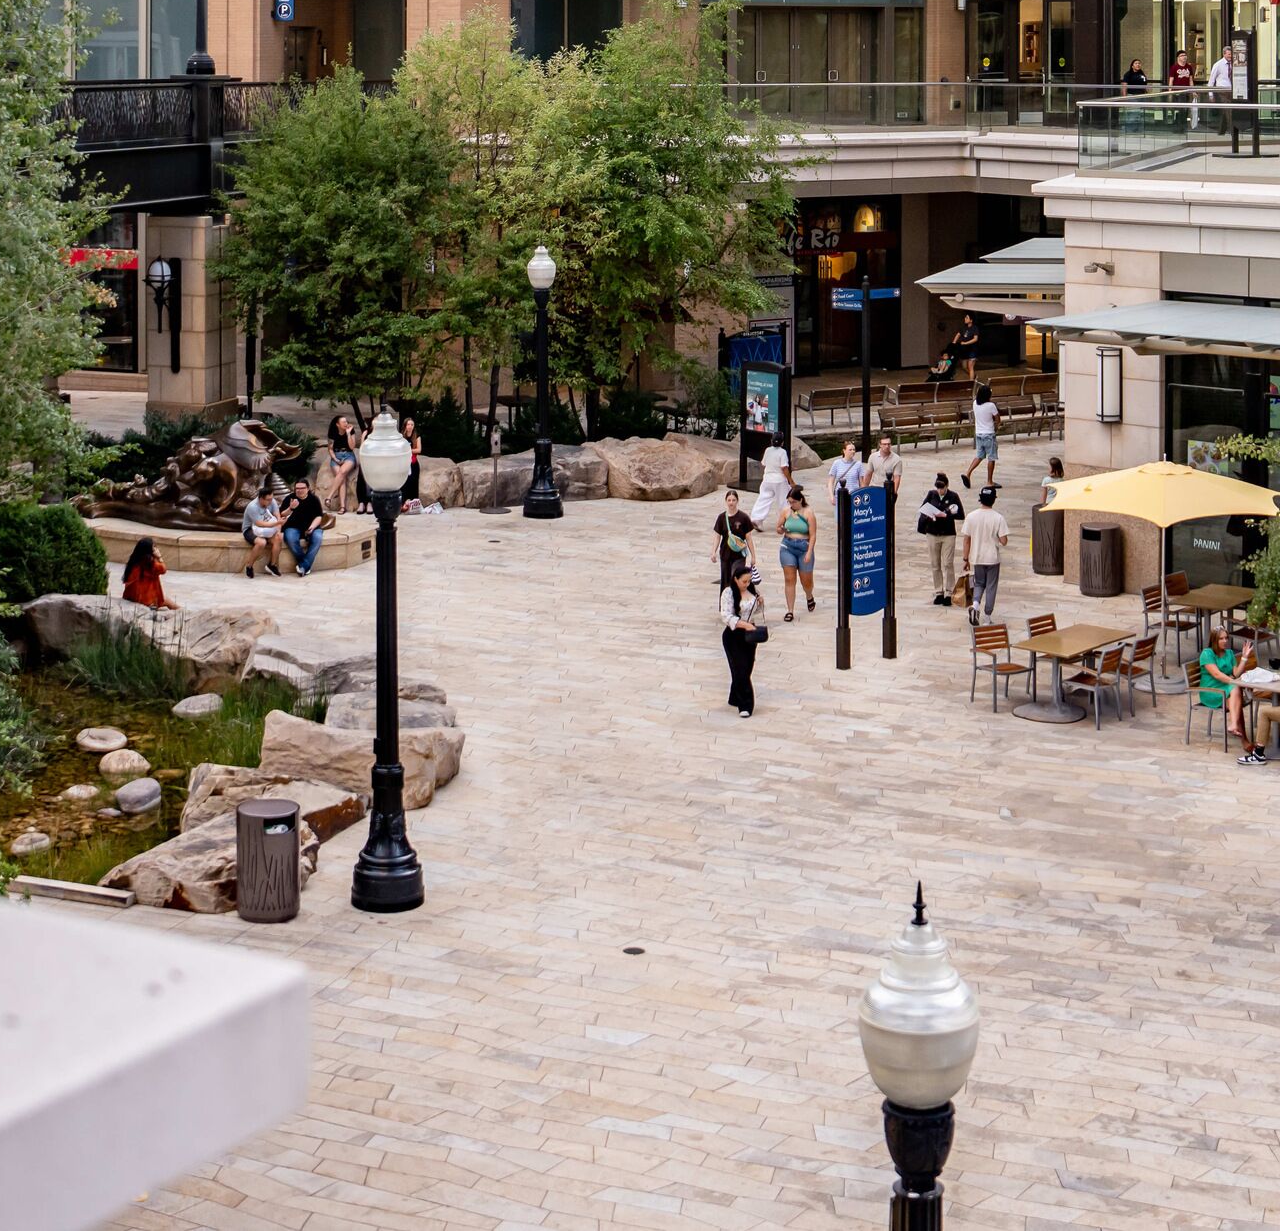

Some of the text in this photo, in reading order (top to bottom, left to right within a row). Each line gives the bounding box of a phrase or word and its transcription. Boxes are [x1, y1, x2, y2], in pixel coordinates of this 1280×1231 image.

[853, 506, 873, 517] Macy's
[1193, 537, 1221, 551] PANINI
[853, 550, 883, 561] Nordstrom
